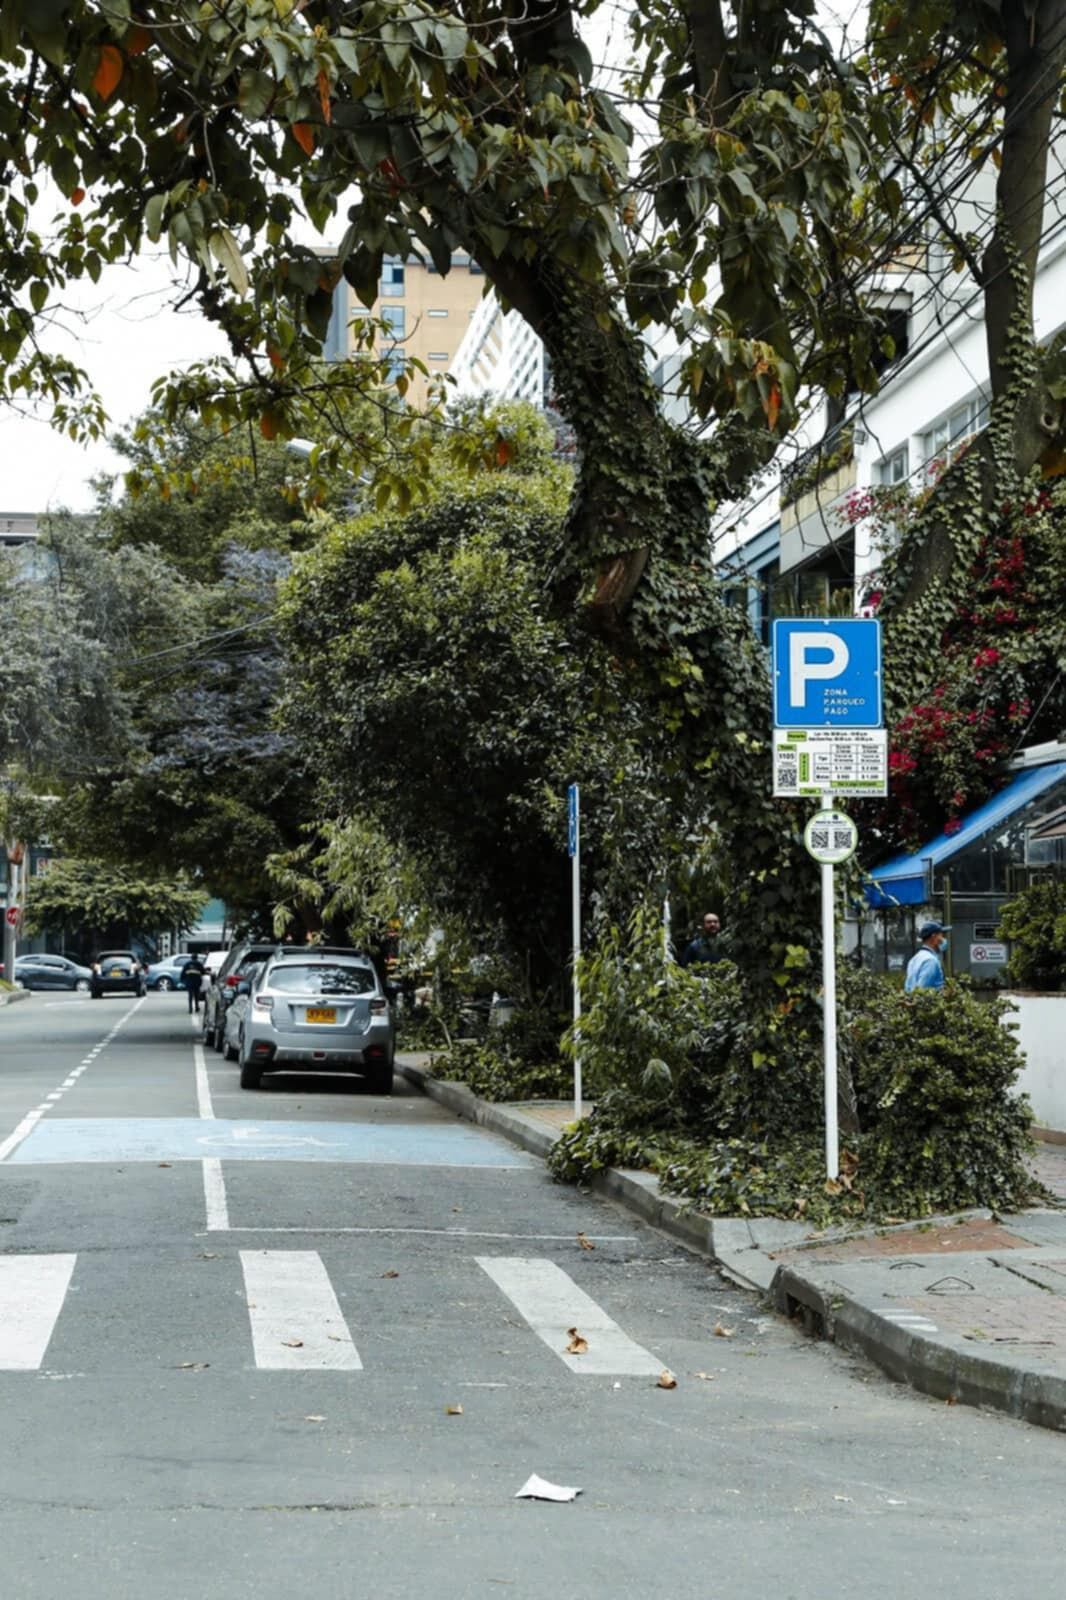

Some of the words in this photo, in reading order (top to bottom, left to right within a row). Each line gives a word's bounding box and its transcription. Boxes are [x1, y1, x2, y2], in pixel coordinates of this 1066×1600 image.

[789, 632, 849, 707] P
[823, 688, 848, 696] ZONA
[823, 698, 866, 706] PARQUEO
